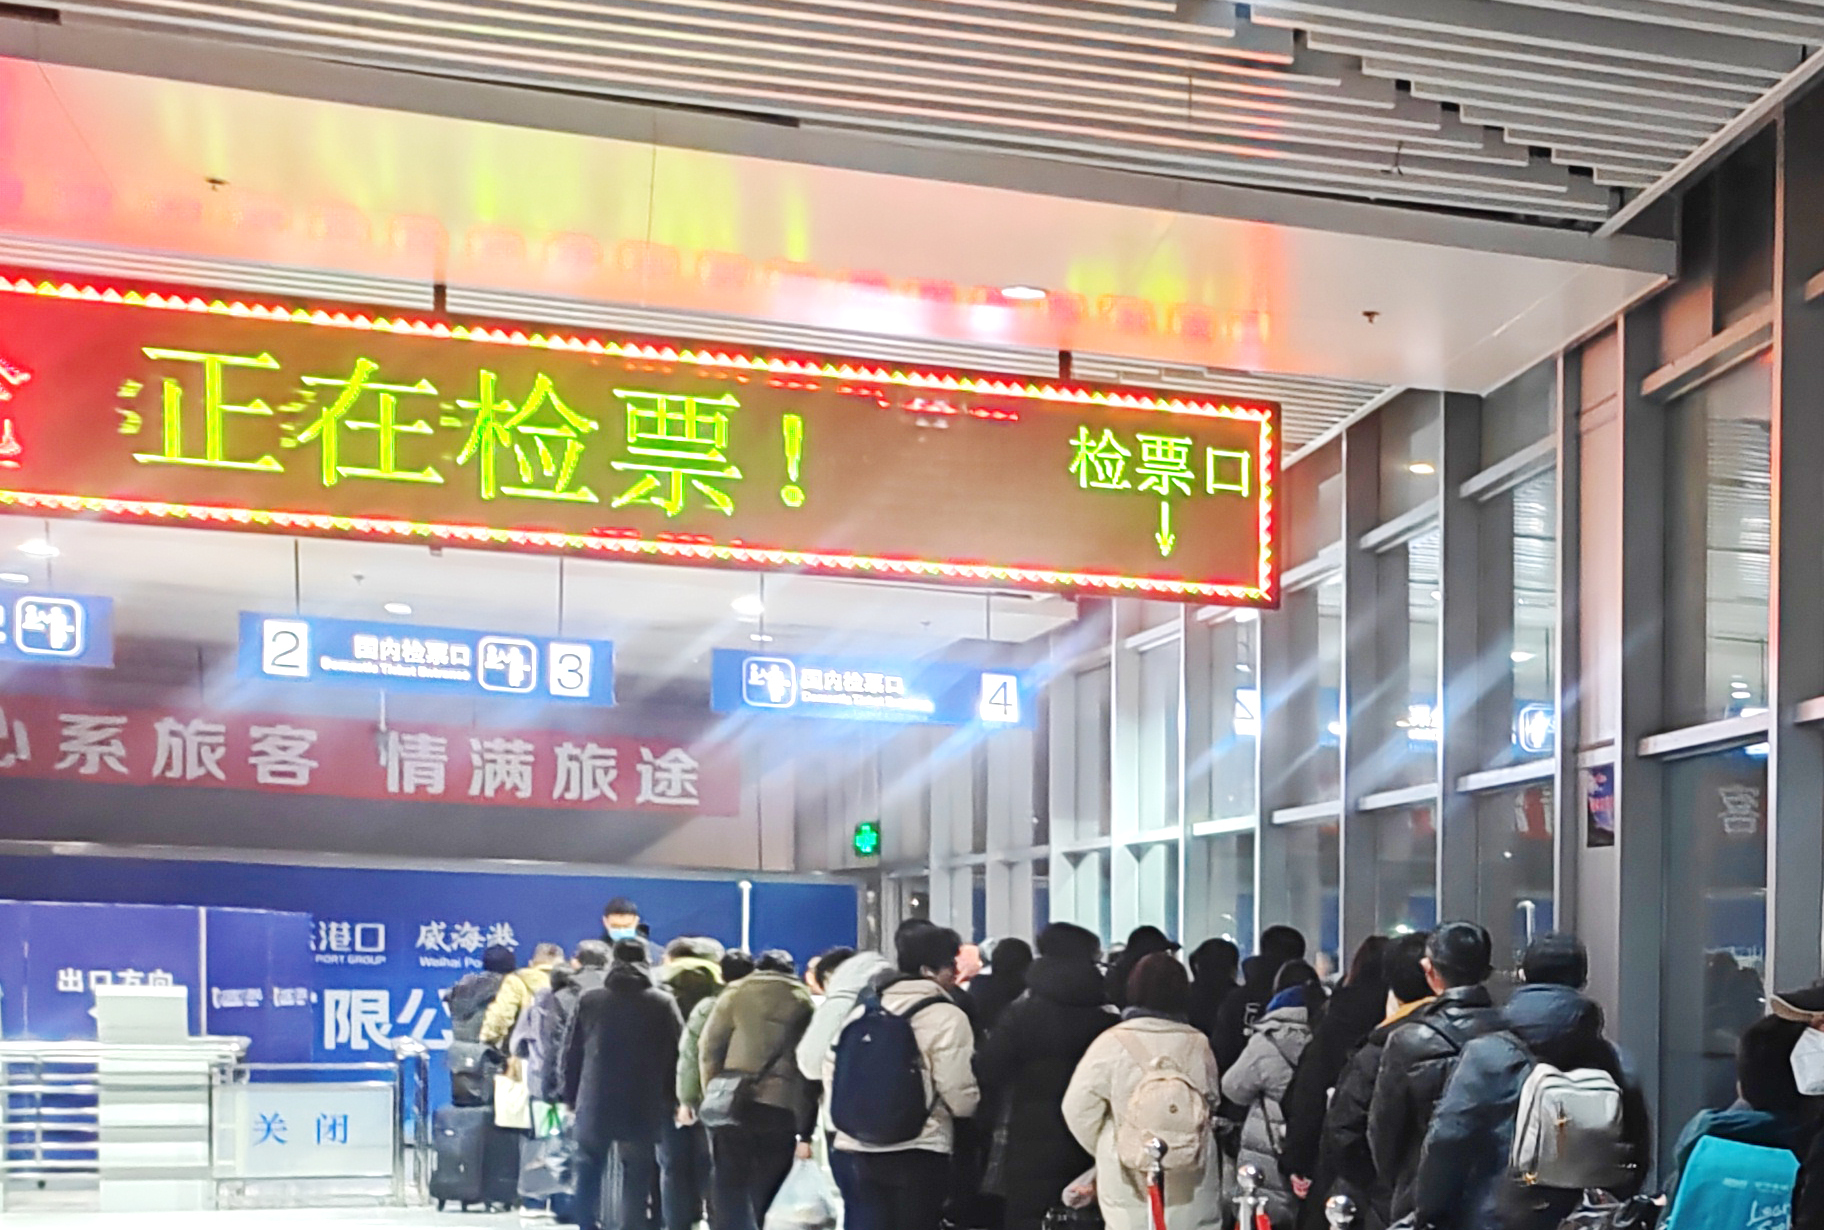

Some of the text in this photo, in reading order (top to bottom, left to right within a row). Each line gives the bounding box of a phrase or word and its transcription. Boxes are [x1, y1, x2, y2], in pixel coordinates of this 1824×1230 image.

[1067, 424, 1251, 498] 检票口
[272, 631, 300, 668] 2
[353, 634, 471, 666] 国内检票口
[557, 653, 584, 689] 3
[988, 681, 1013, 715] 4
[385, 732, 700, 807] 情满旅途
[310, 920, 386, 952] 港口
[420, 955, 461, 968] Weihai
[253, 1112, 349, 1146] 关闭
